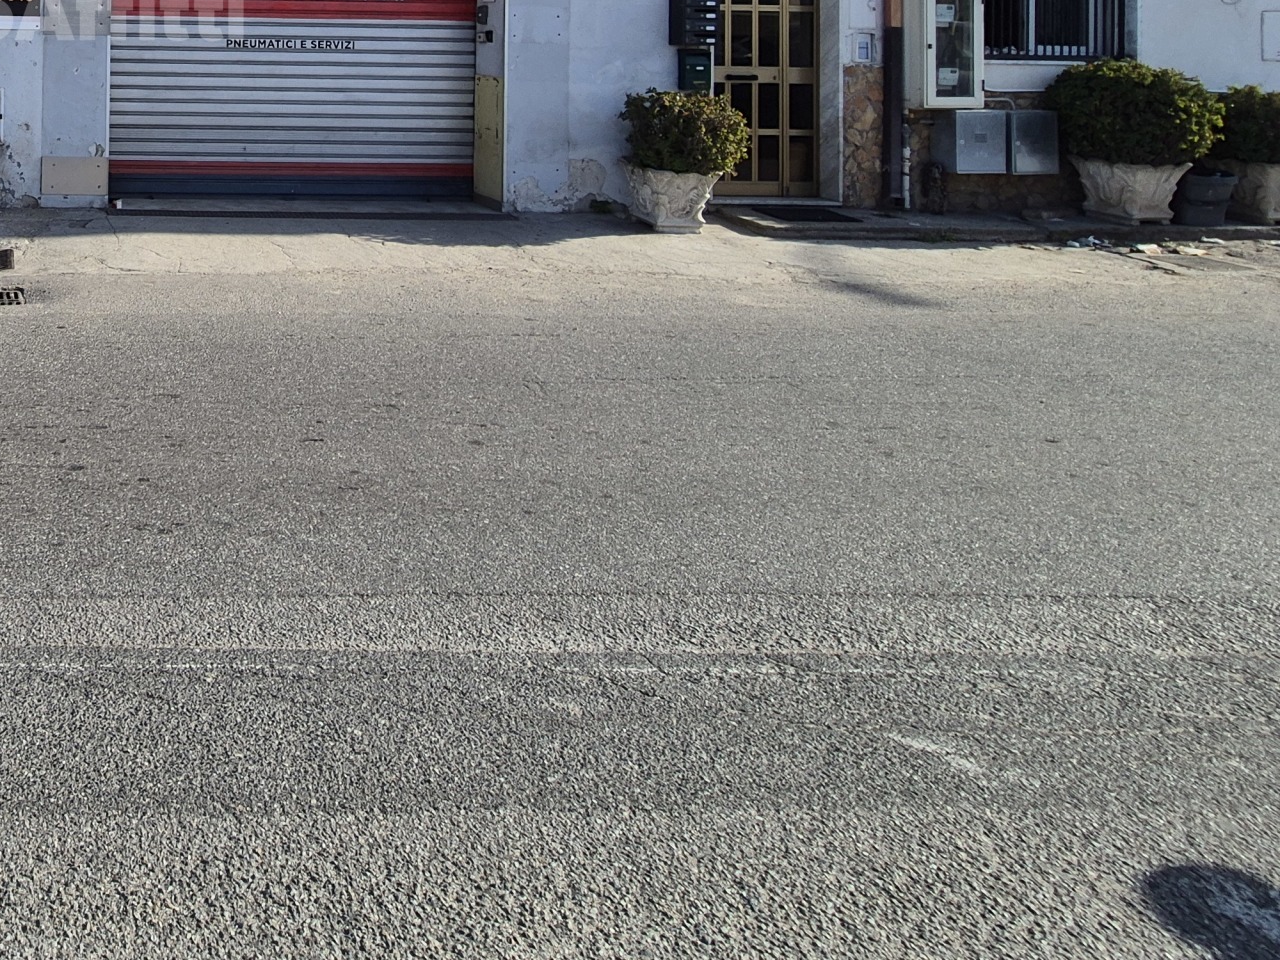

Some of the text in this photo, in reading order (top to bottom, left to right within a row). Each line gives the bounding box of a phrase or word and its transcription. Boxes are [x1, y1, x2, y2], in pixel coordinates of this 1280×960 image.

[226, 39, 355, 50] PNEUMATICI E SERVIZI
